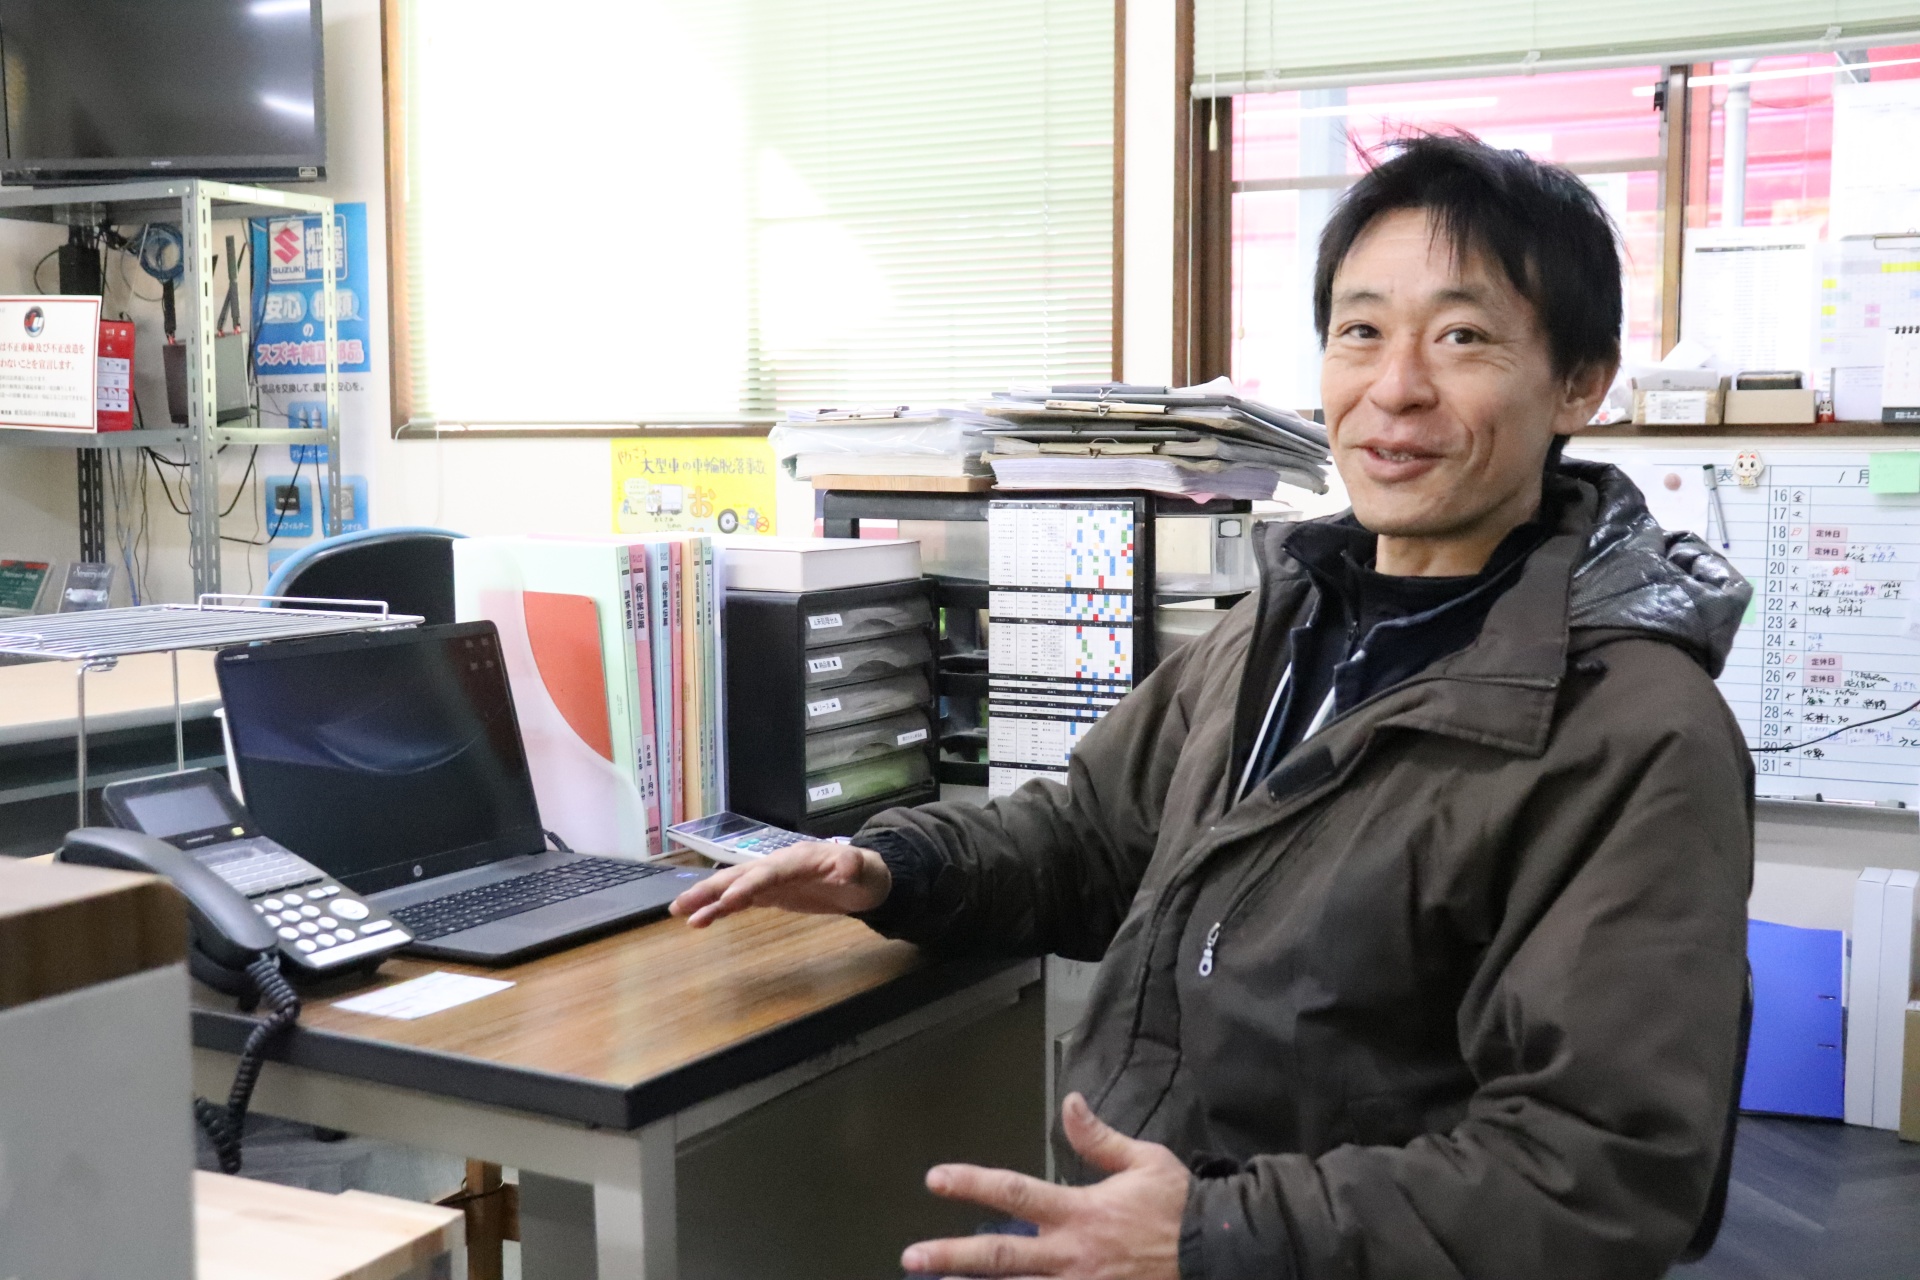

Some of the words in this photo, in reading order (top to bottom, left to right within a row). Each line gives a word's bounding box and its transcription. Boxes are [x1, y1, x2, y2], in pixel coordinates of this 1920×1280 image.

[272, 266, 304, 274] SUZUKI
[264, 294, 301, 319] 安心
[303, 323, 314, 337] の
[641, 456, 767, 475] 大型車の車輪脱落事故
[1717, 468, 1734, 483] 表
[688, 485, 716, 518] お
[1774, 489, 1787, 502] 16
[1773, 507, 1786, 520] 17
[1772, 525, 1786, 538] 18
[1816, 529, 1840, 538] 定休日
[1771, 544, 1785, 557] 19
[1814, 547, 1839, 556] 定休日
[1770, 562, 1785, 575] 20
[1769, 580, 1783, 593] 21
[1768, 598, 1783, 611] 22
[1767, 616, 1783, 629] 23
[1766, 634, 1782, 647] 24
[1766, 652, 1781, 665] 25
[1811, 658, 1836, 666] 定休日
[1765, 670, 1780, 683] 26
[1810, 675, 1834, 683] 定休日
[1765, 688, 1780, 701] 27
[1764, 706, 1779, 718] 28
[1763, 724, 1778, 736] 29
[1763, 742, 1777, 754] 30
[1762, 759, 1775, 772] 31
